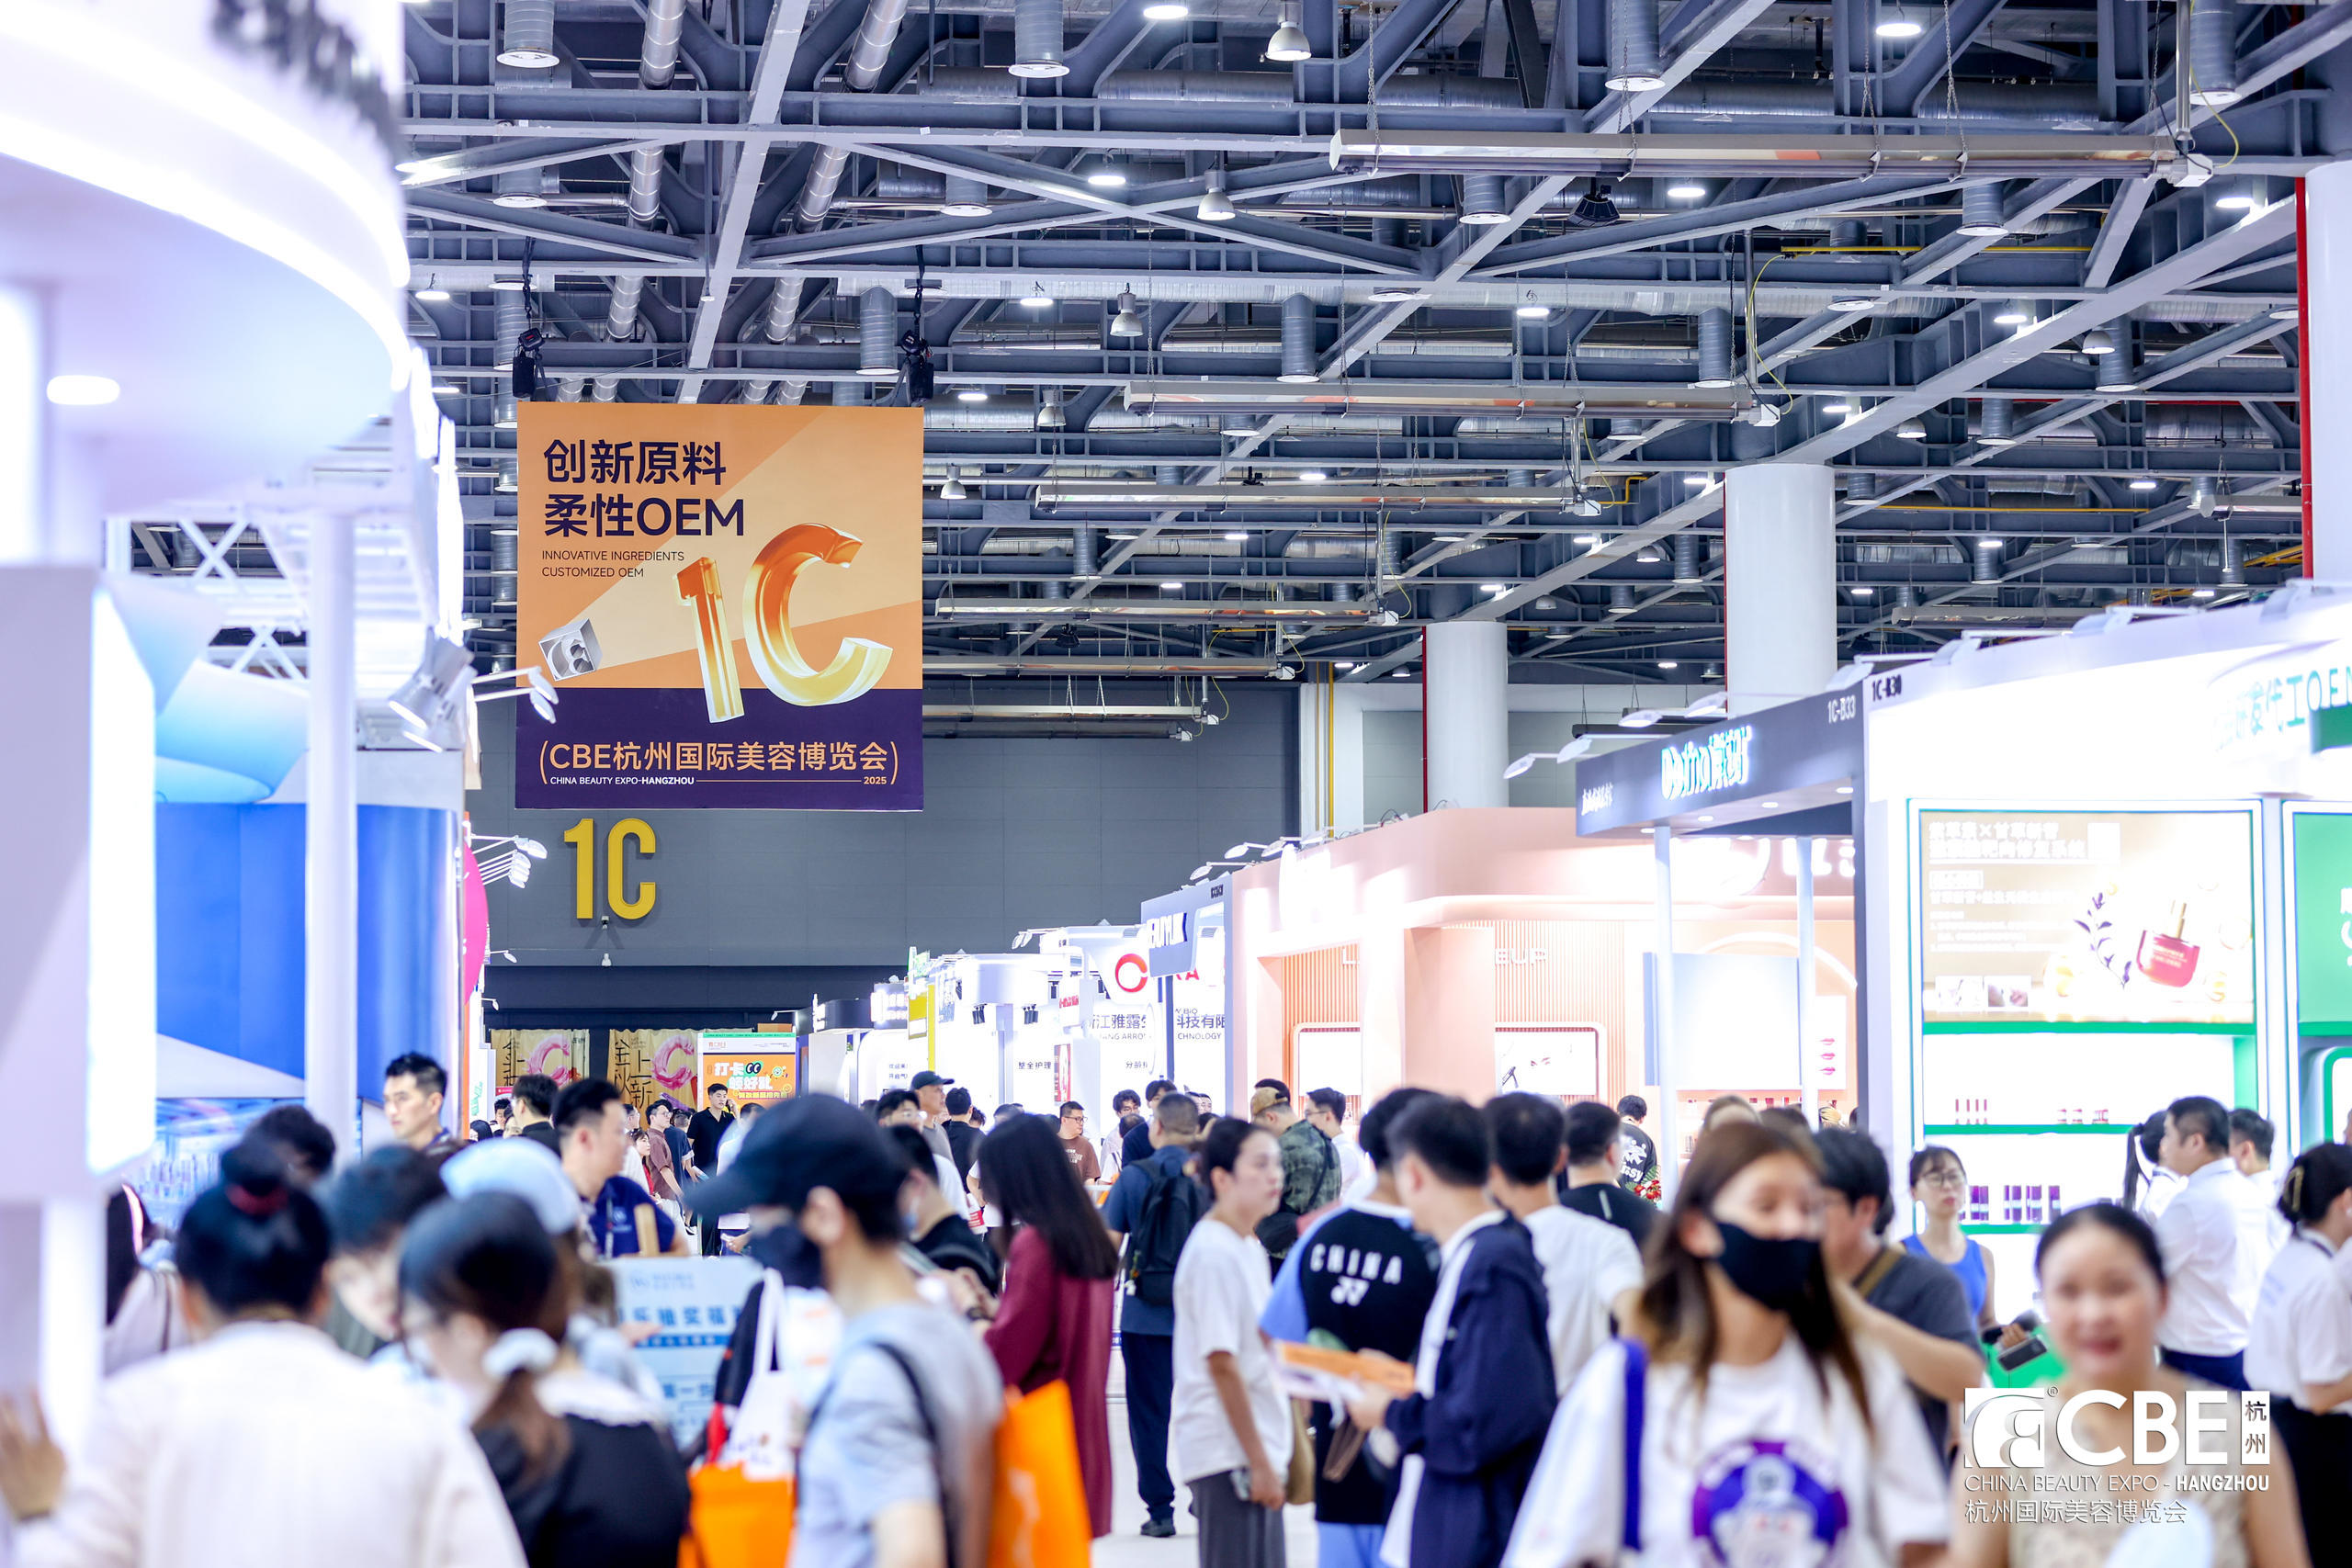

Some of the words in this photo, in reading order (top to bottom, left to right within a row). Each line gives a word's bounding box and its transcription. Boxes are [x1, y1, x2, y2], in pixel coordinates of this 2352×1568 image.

[543, 439, 726, 486] 创新原料
[544, 493, 745, 537] 柔性OEM
[542, 550, 607, 560] INNOVATIVE
[611, 551, 684, 561] INGREDIENTS
[542, 567, 615, 577] CUSTOMIZED
[618, 568, 644, 578] OEM
[672, 522, 893, 724] 1C
[1827, 694, 1856, 724] 1C-B33
[864, 776, 888, 785] 2025
[563, 818, 656, 919] 1C
